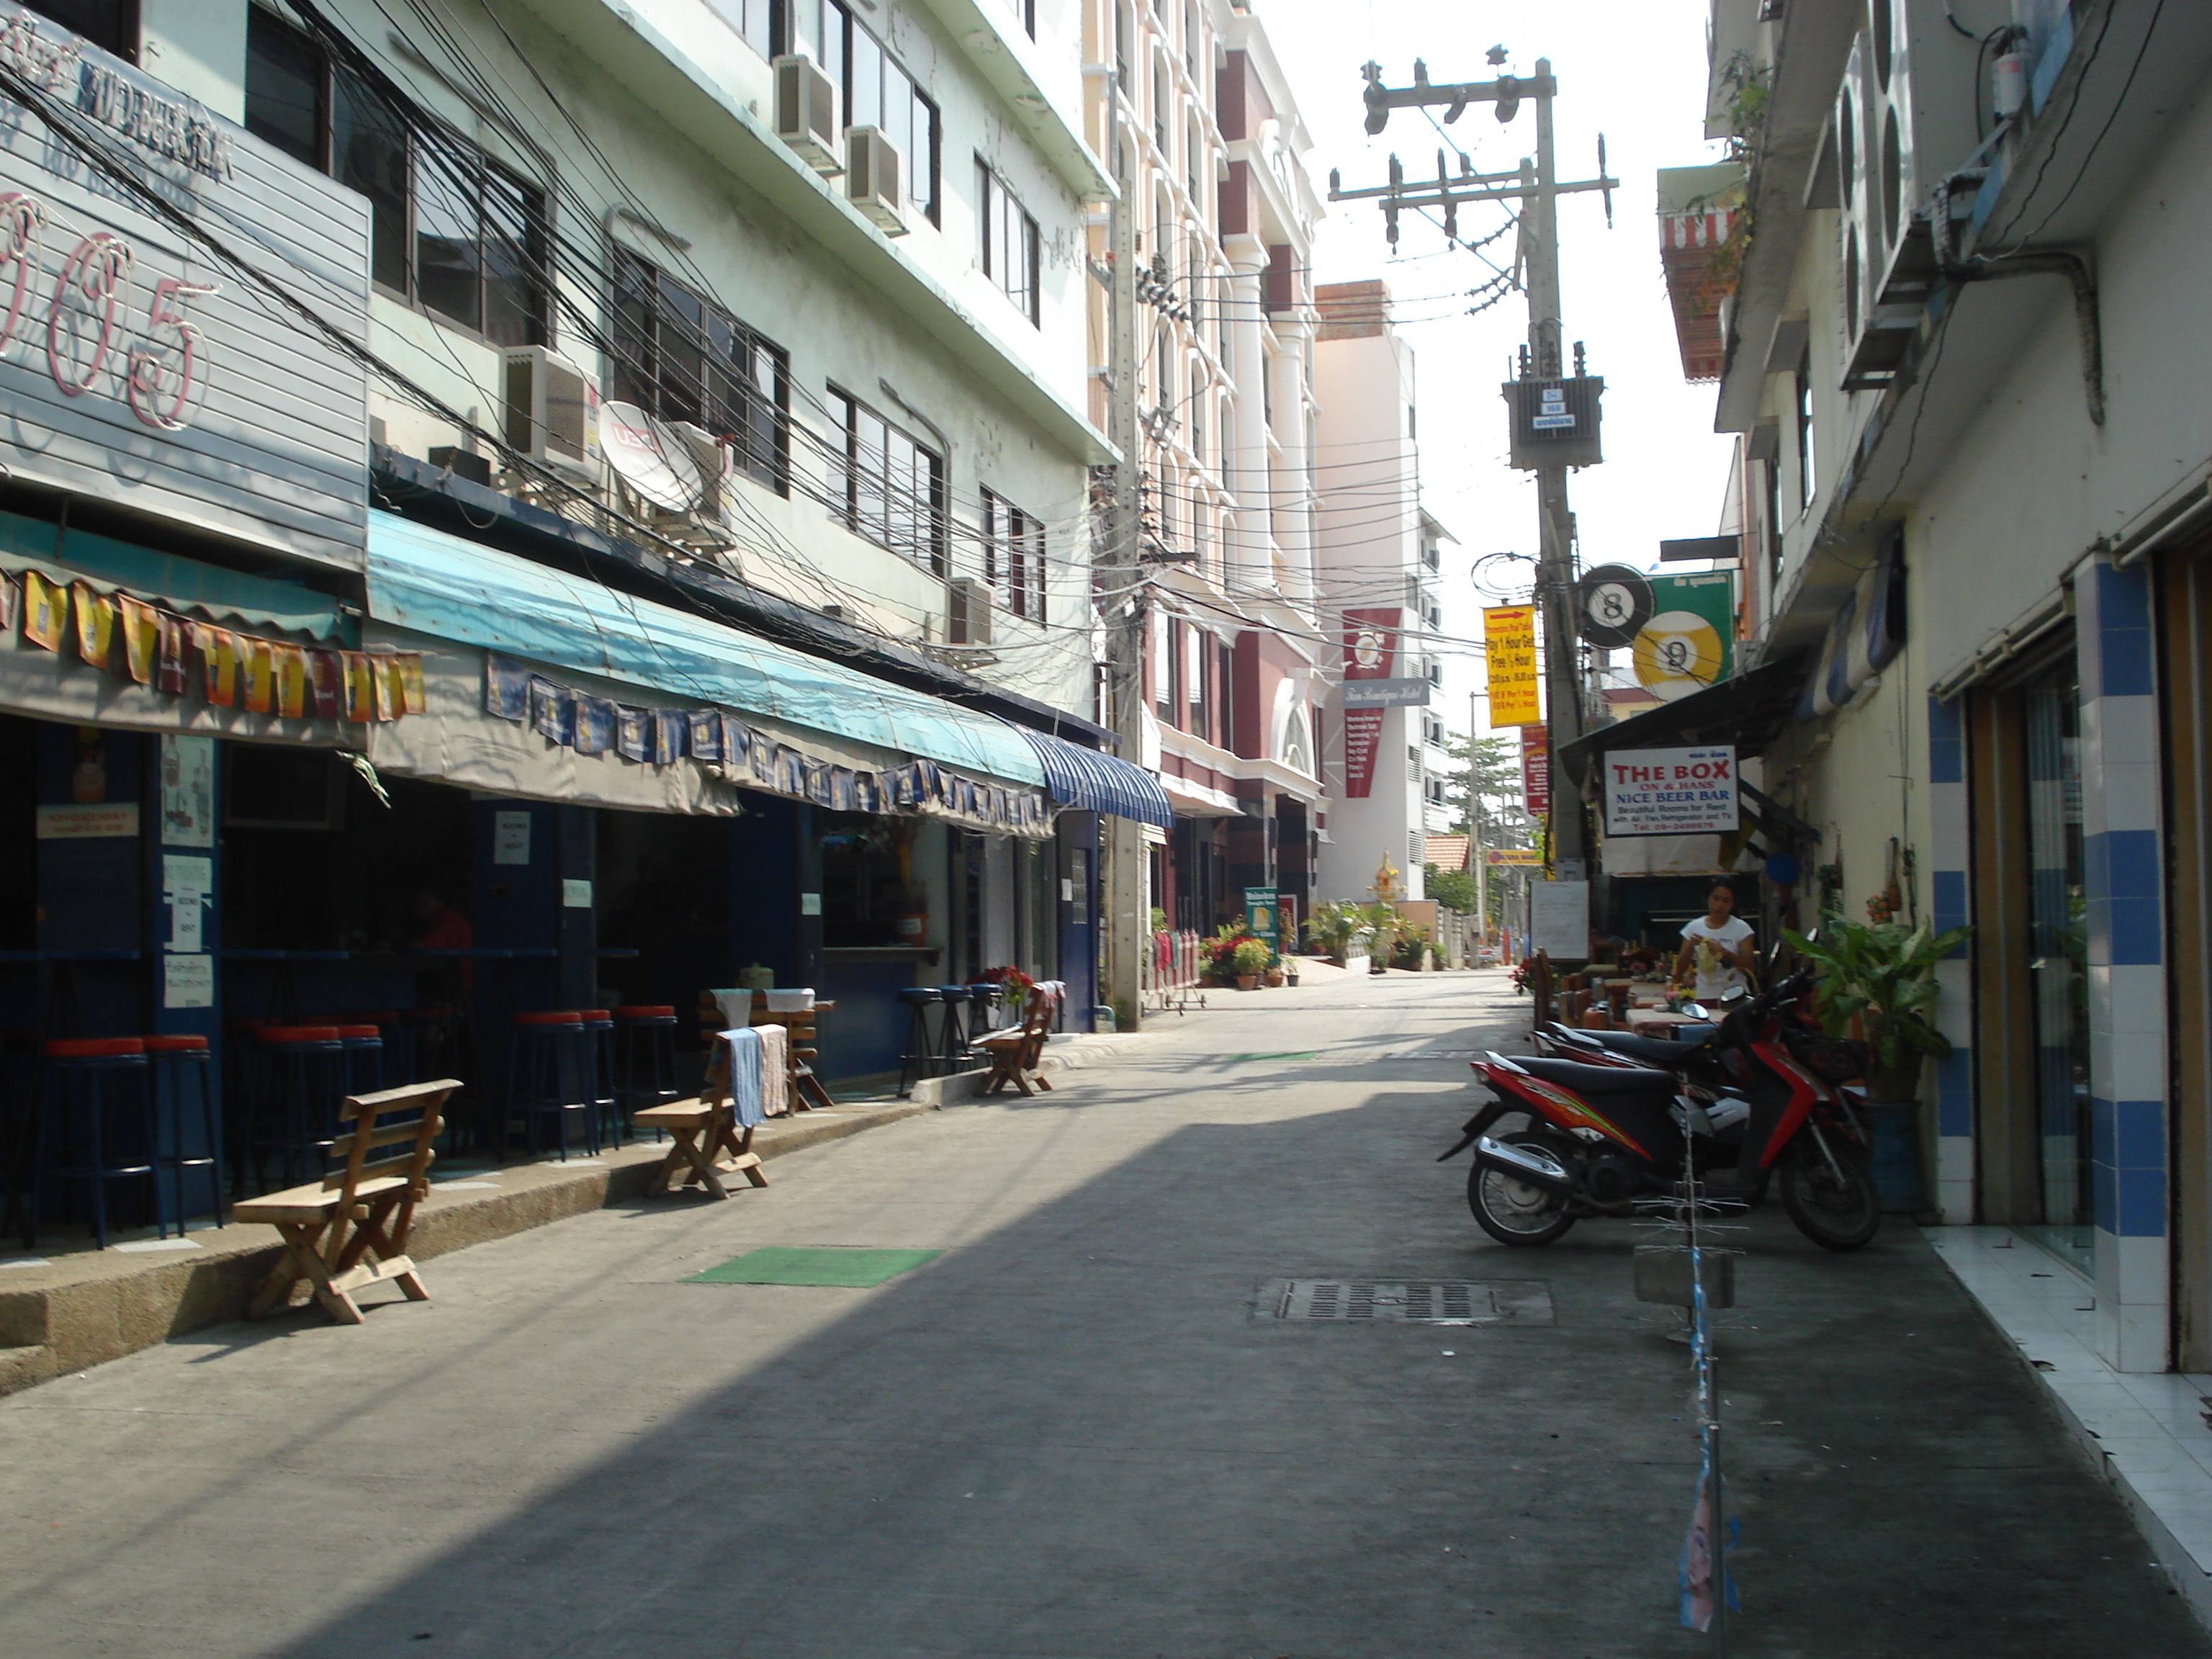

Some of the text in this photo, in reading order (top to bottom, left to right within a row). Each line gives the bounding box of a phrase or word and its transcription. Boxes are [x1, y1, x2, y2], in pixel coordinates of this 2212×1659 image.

[1604, 593, 1622, 619] 8
[1505, 637, 1521, 649] Hour
[1491, 655, 1506, 668] Free
[1514, 653, 1531, 666] Hour
[1668, 641, 1686, 667] 9
[1612, 759, 1730, 784] THE BOX
[1616, 790, 1730, 804] NICE BEER BAR
